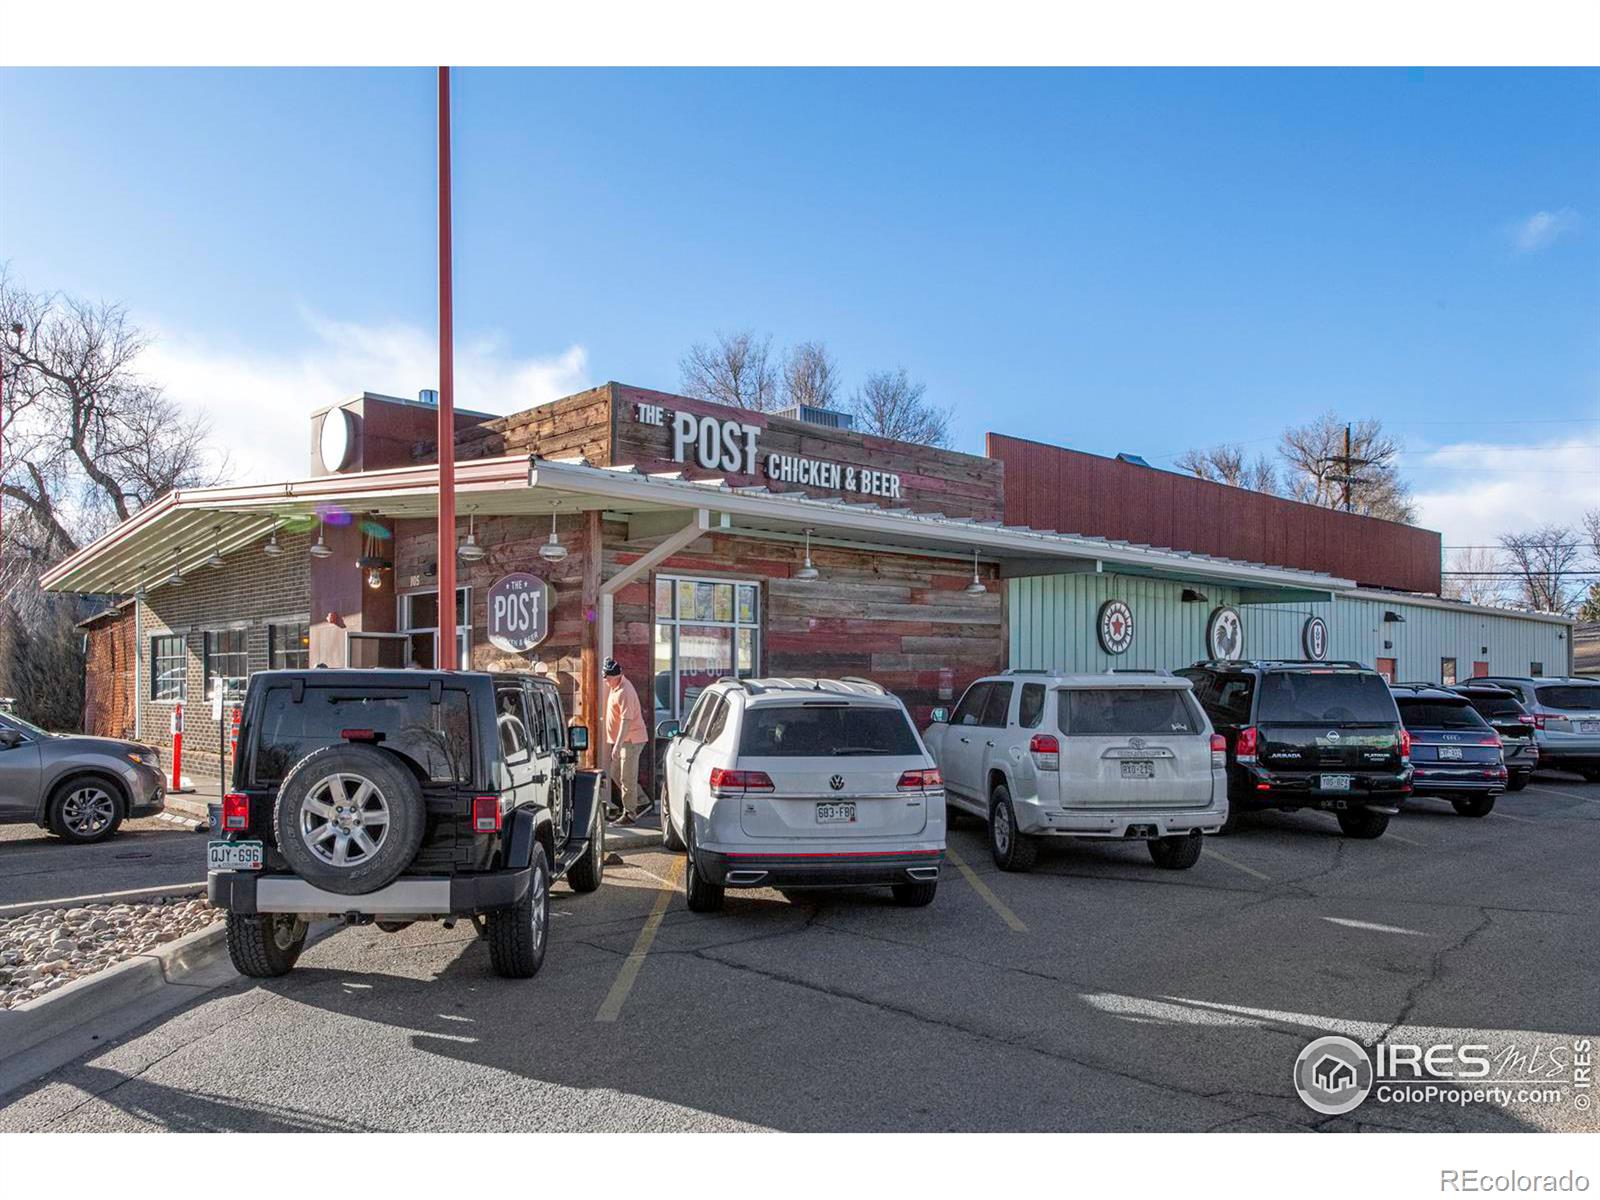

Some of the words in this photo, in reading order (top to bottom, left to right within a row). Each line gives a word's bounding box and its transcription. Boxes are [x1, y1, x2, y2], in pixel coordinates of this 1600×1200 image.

[637, 402, 663, 426] THE
[672, 410, 761, 475] POST
[768, 453, 840, 490] CHICKEN
[845, 466, 857, 491] &
[860, 470, 900, 498] BEER
[511, 580, 522, 590] THE
[494, 591, 541, 632] POST
